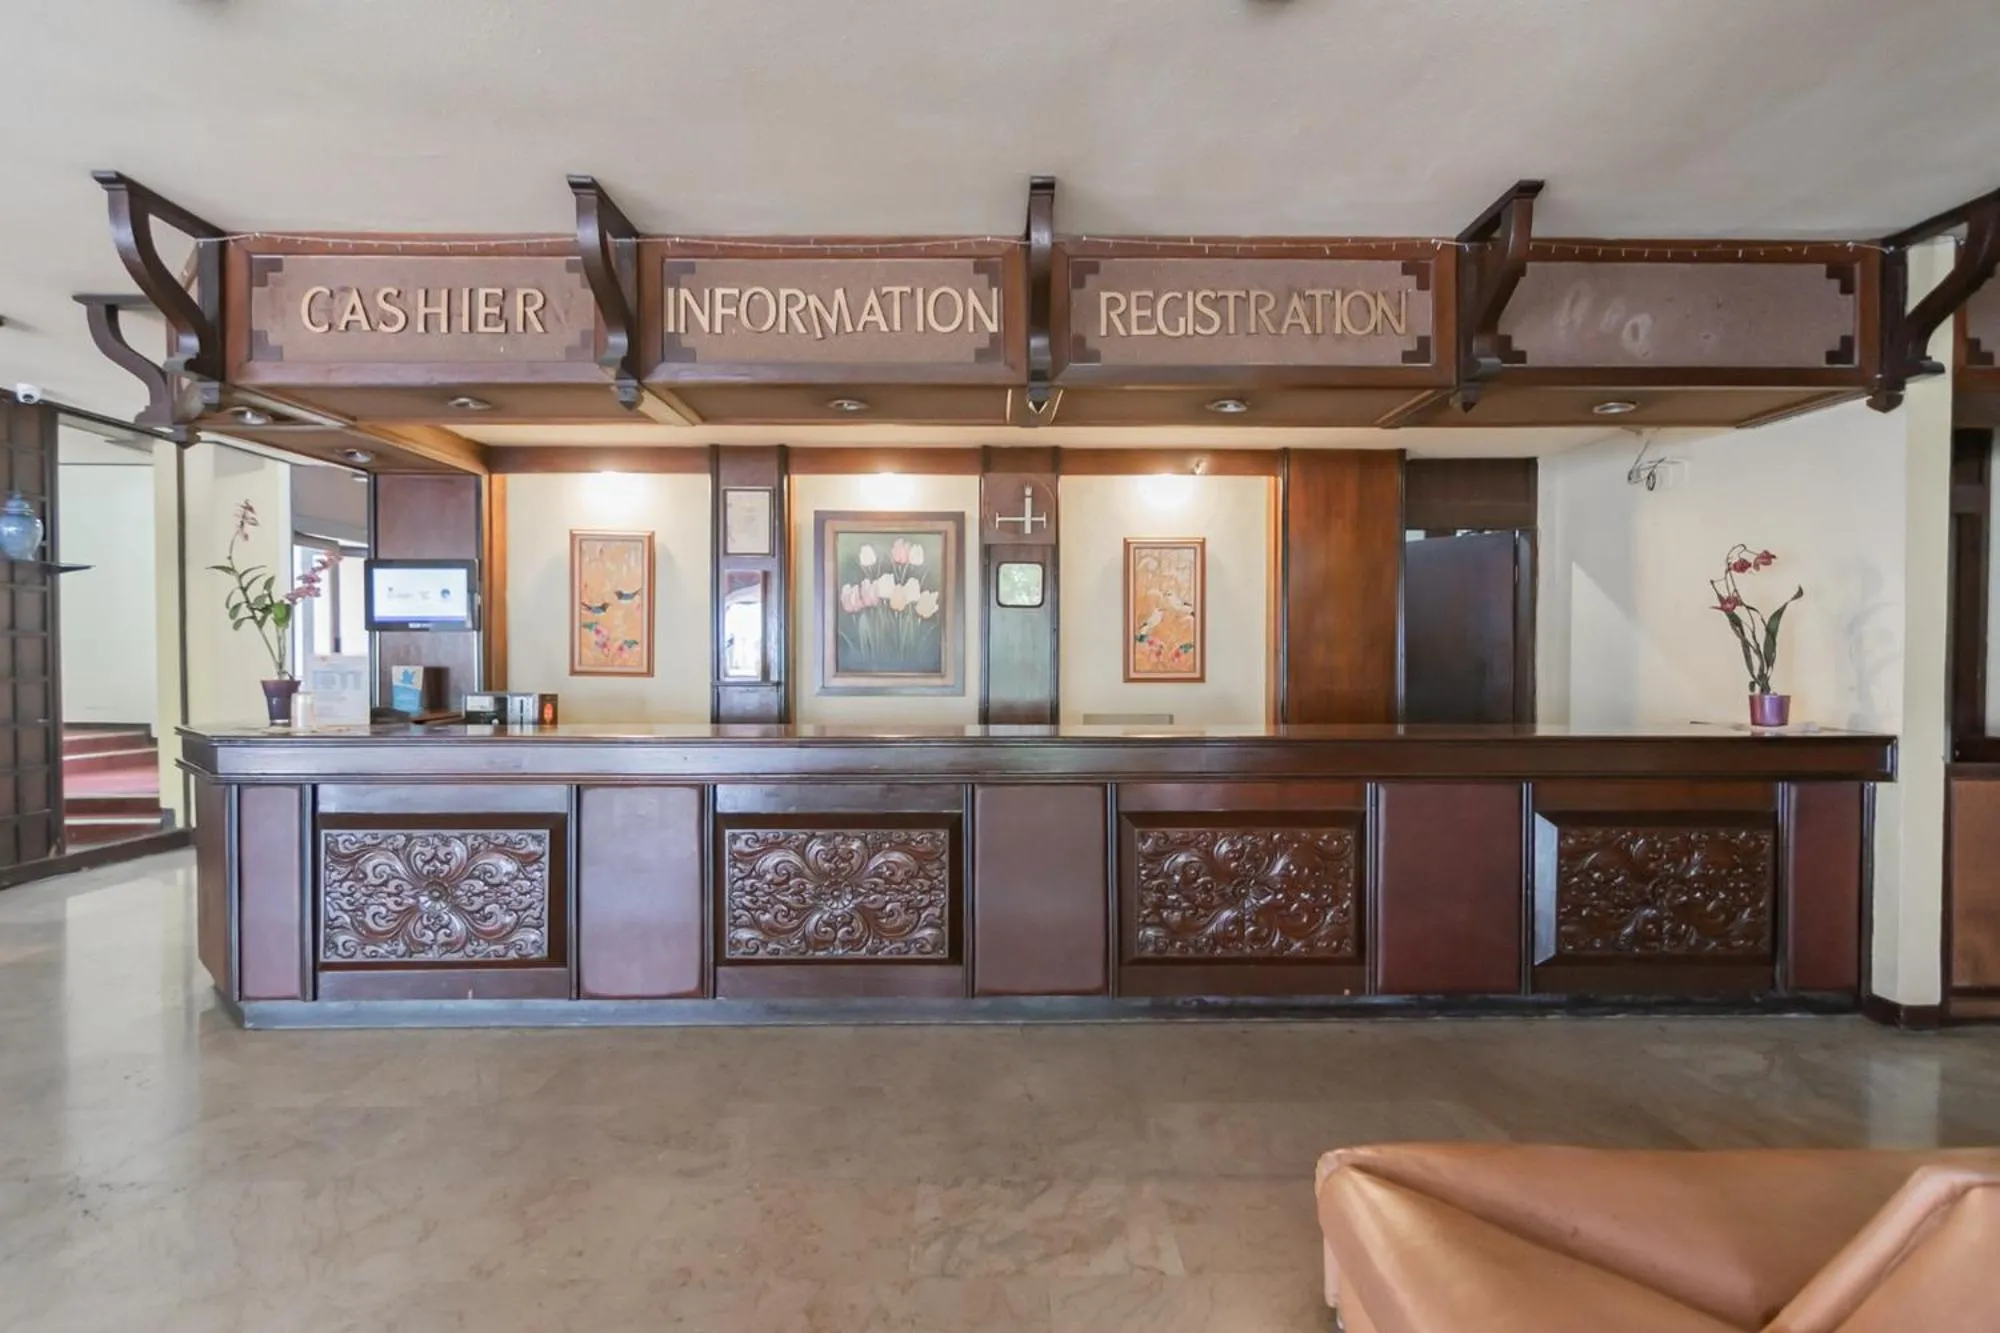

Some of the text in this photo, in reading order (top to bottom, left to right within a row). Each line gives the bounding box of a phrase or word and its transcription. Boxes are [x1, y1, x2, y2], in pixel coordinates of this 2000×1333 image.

[301, 286, 547, 333] CASHIER
[667, 286, 999, 339] INFORMATION
[1100, 289, 1407, 337] REGISTRATION
